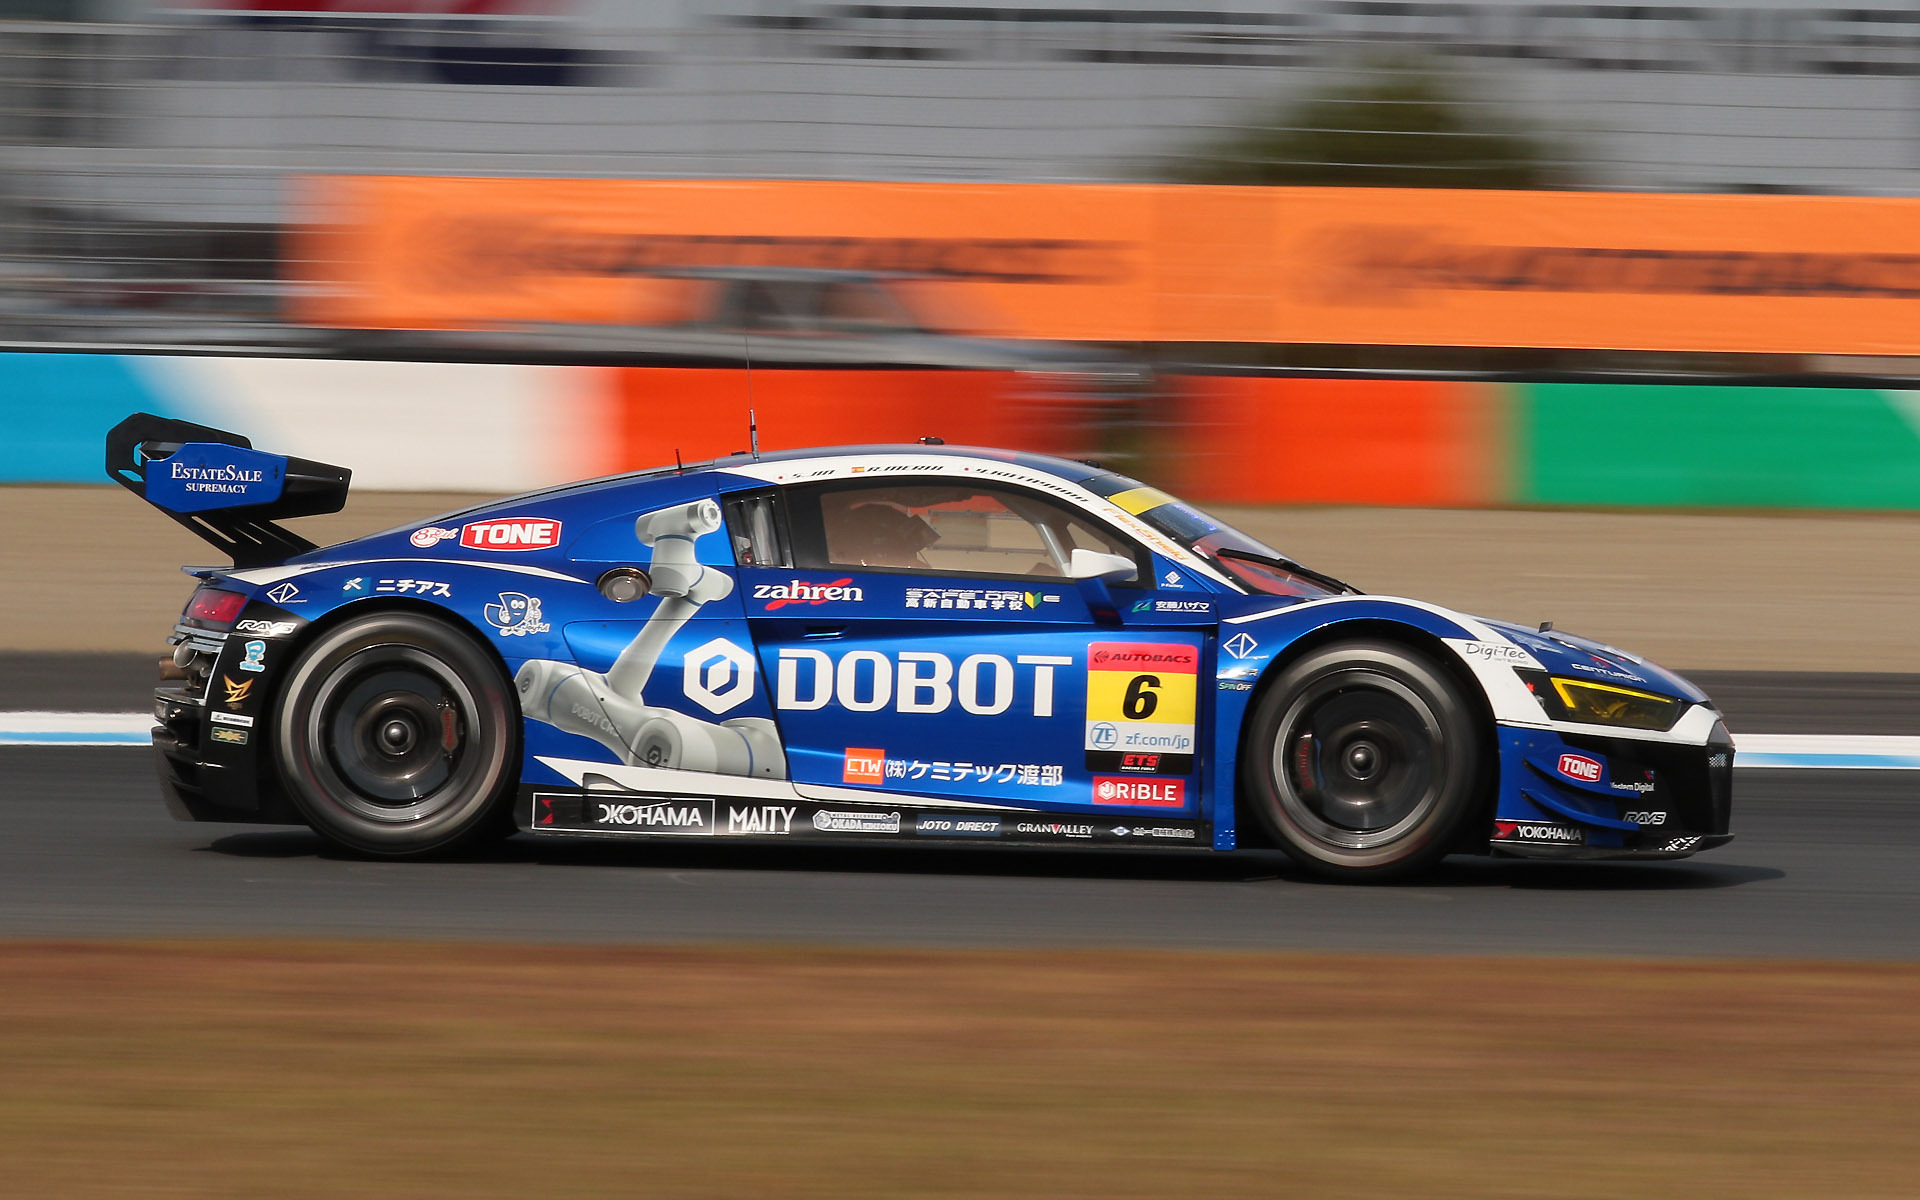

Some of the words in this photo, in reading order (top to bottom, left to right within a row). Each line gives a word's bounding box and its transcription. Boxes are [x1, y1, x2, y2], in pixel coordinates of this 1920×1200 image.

[185, 483, 248, 494] SUPREMACY
[471, 523, 554, 545] TONE
[376, 579, 451, 598] ニチアス
[752, 579, 864, 601] zahren
[905, 598, 1023, 611] 高新自動車学校
[1111, 653, 1191, 664] AUTOBACS
[1465, 642, 1527, 660] Digi-Tec
[777, 648, 1073, 717] DOBOT
[1122, 674, 1163, 720] 6
[1095, 728, 1113, 743] ZF
[1126, 733, 1190, 749] zf.com/jp
[847, 758, 881, 773] CTW
[1123, 754, 1159, 767] ETS
[1563, 757, 1599, 779] TONE
[885, 759, 1064, 787] (株)ケミテック渡部
[1115, 781, 1177, 801] RiBLE
[728, 806, 797, 832] MAITY
[831, 819, 861, 829] OKADA
[1623, 811, 1667, 825] RAYS
[955, 822, 999, 832] DIRECT
[1016, 822, 1094, 835] GRANVALLEY
[1517, 825, 1582, 841] YOKOHAMA
